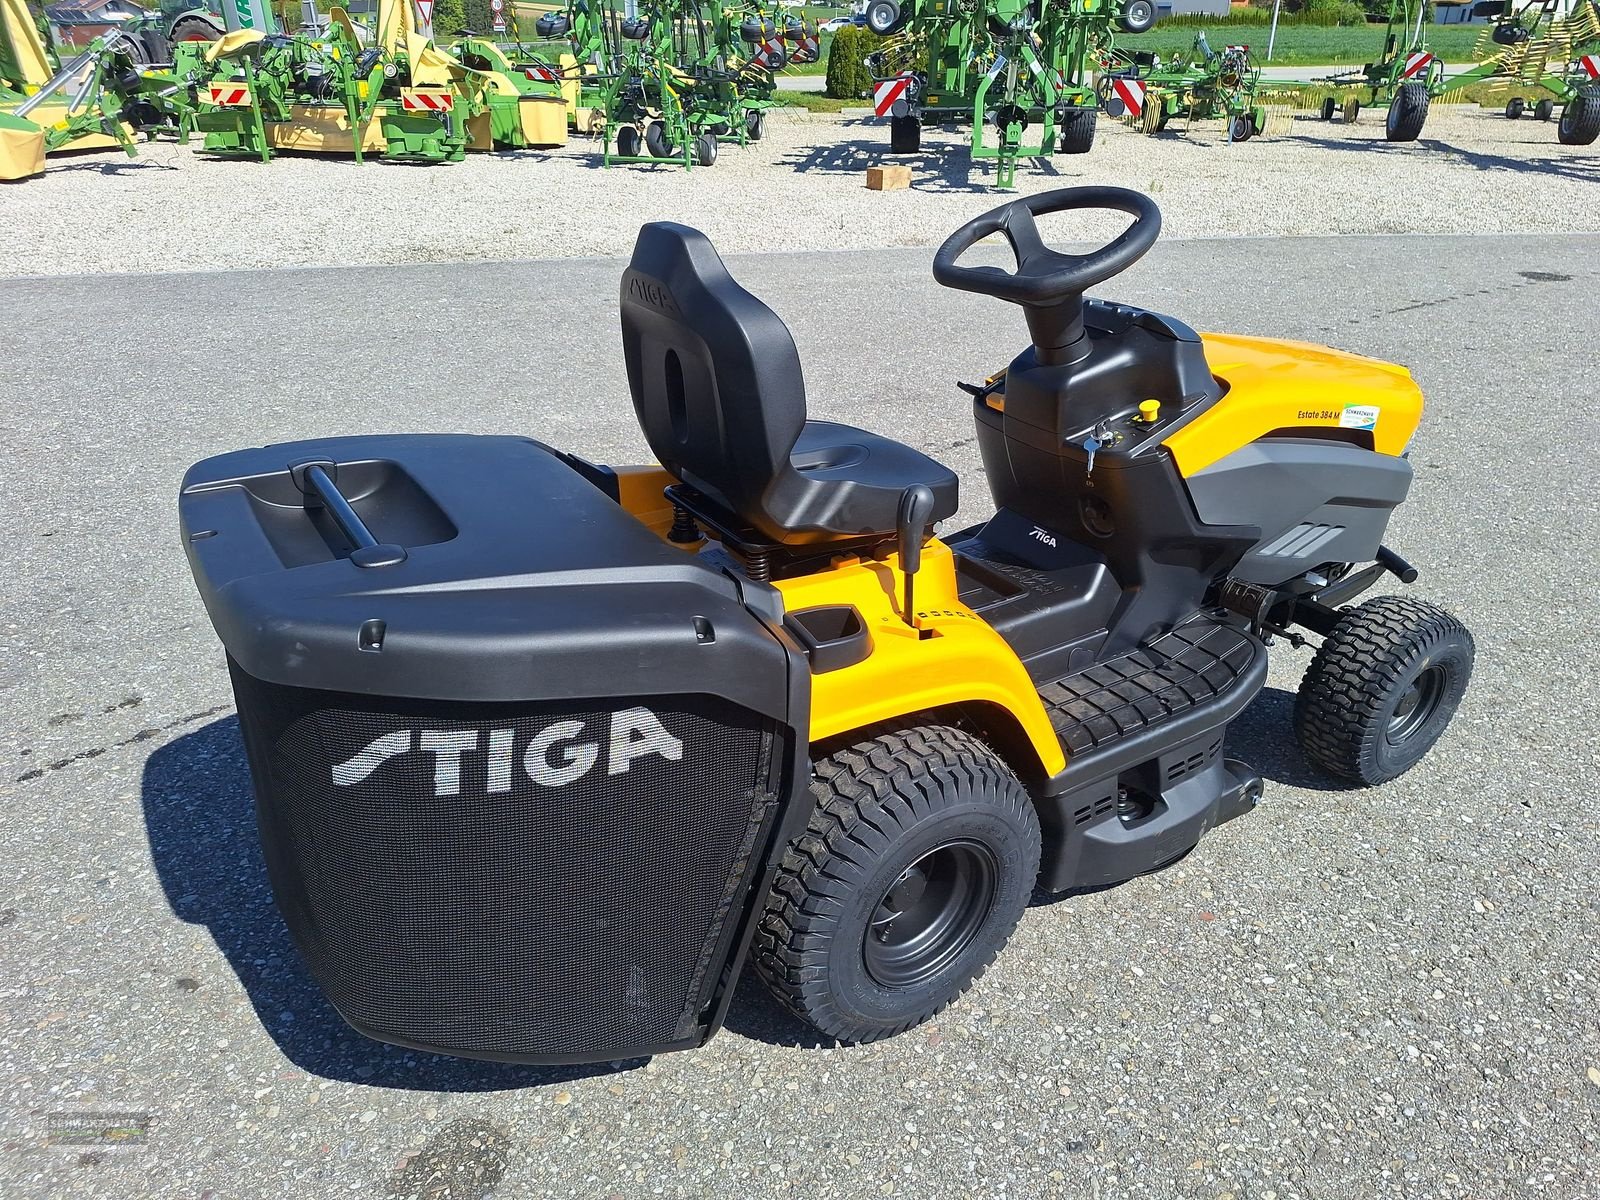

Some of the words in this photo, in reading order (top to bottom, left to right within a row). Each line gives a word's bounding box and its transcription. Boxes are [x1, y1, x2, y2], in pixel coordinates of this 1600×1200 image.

[1297, 410, 1319, 419] Estate
[1320, 411, 1333, 419] 384
[1028, 525, 1057, 548] STIGA
[331, 704, 684, 797] STIGA
